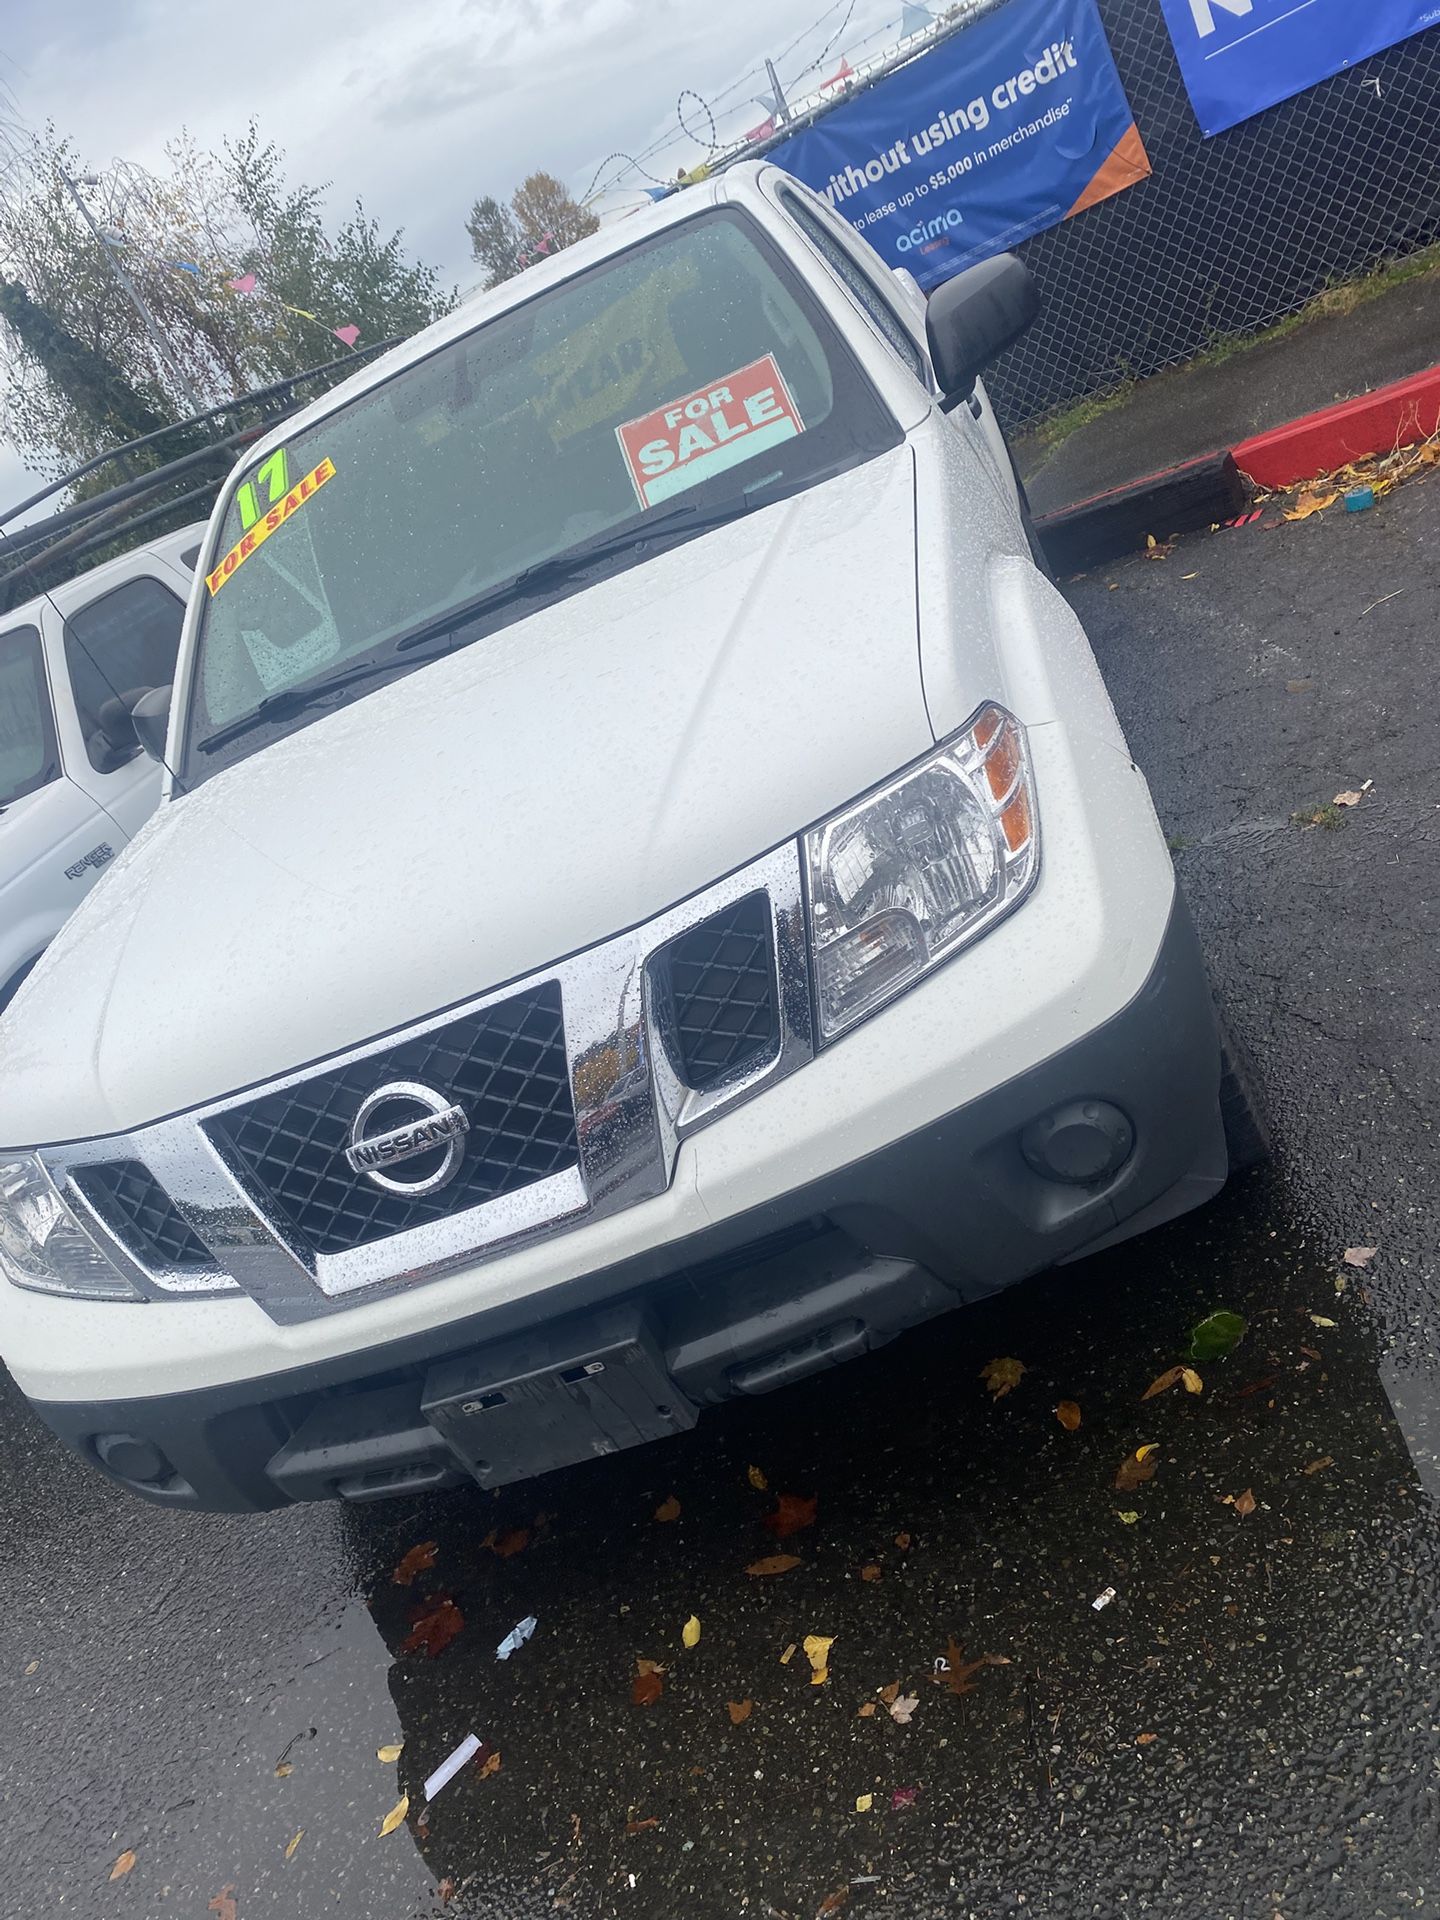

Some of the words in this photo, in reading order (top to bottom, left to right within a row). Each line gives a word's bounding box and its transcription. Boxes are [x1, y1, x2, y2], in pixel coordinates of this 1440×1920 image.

[911, 96, 990, 156] using
[853, 219, 866, 231] to
[864, 201, 897, 225] lease
[898, 192, 915, 210] up
[915, 183, 929, 199] to
[929, 156, 973, 190] $5,000
[973, 149, 988, 167] in
[895, 208, 964, 252] acima
[637, 386, 785, 476] SALE
[663, 386, 735, 430] FOR
[236, 447, 290, 530] 17
[210, 532, 257, 593] FOR
[265, 461, 330, 531] SALE
[354, 1117, 452, 1168] NISSAN
